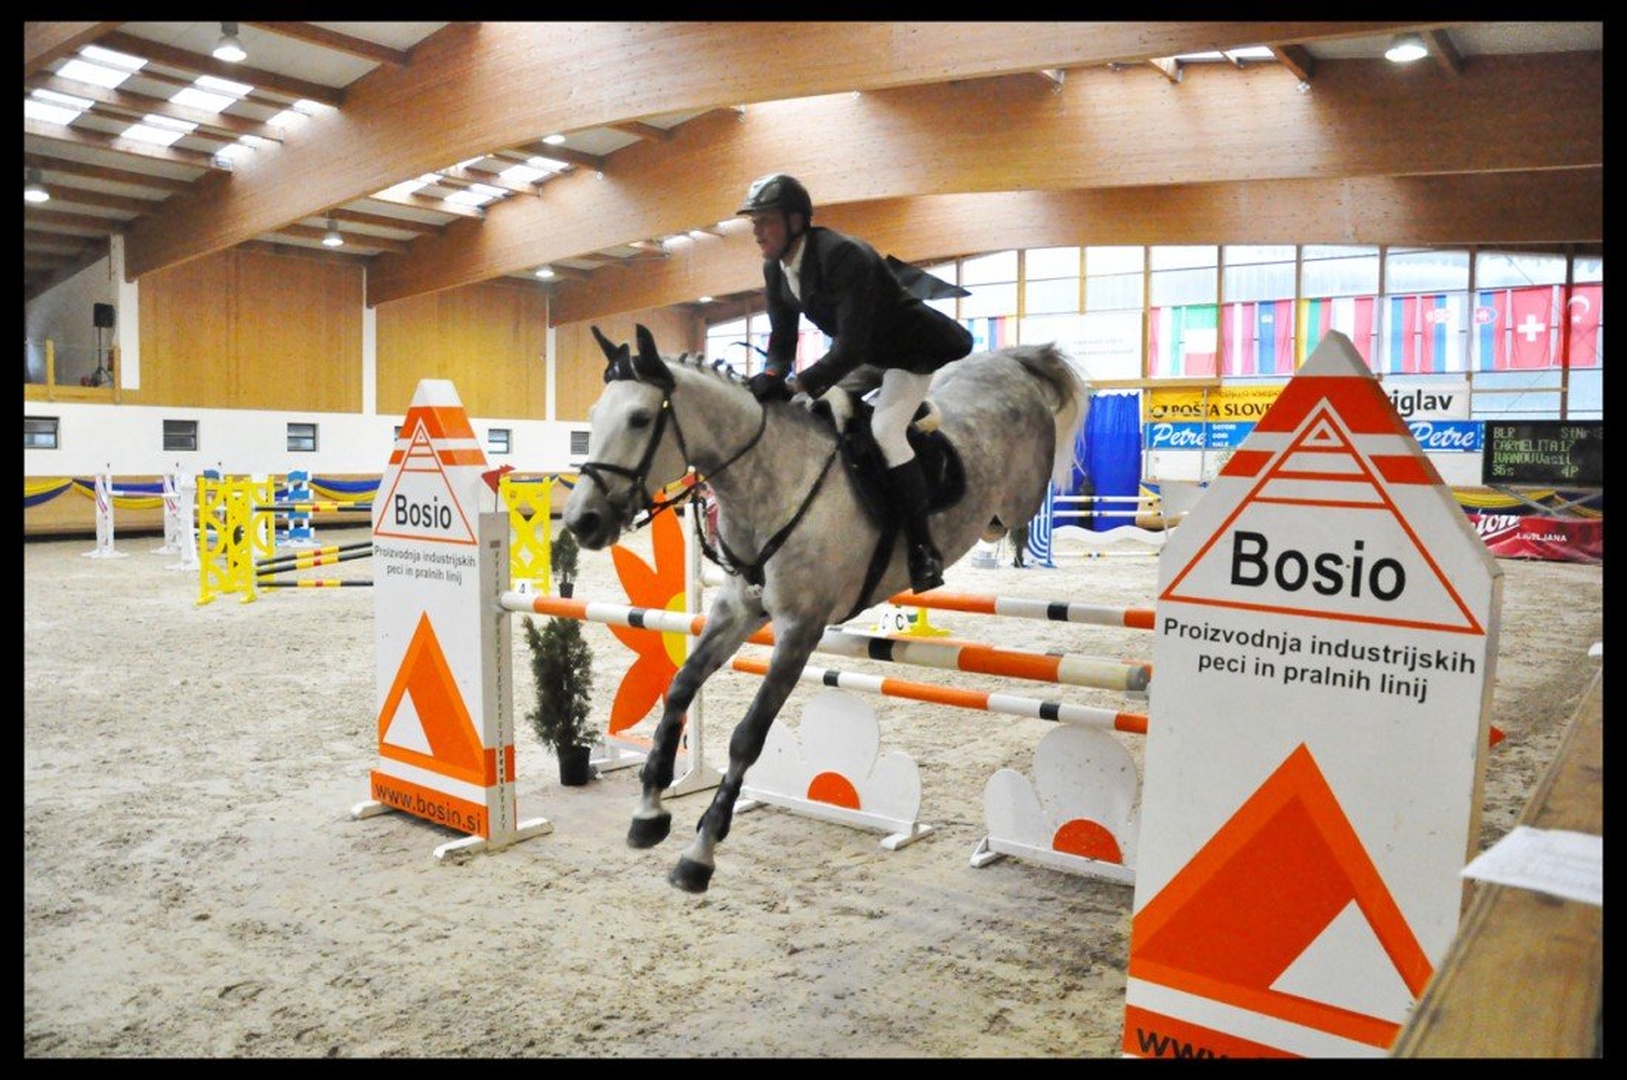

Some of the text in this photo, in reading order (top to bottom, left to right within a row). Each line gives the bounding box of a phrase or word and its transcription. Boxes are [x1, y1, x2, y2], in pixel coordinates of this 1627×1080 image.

[1389, 389, 1453, 417] iglav
[395, 494, 452, 529] Bosio
[374, 545, 476, 569] Proizvodnja industrijskih
[1230, 530, 1406, 602] Bosio
[387, 563, 463, 586] peci in pralnih linij
[895, 613, 904, 631] C
[1163, 617, 1476, 674] Proizvodnja industrijskih
[1198, 652, 1429, 704] peci in pralnih linij
